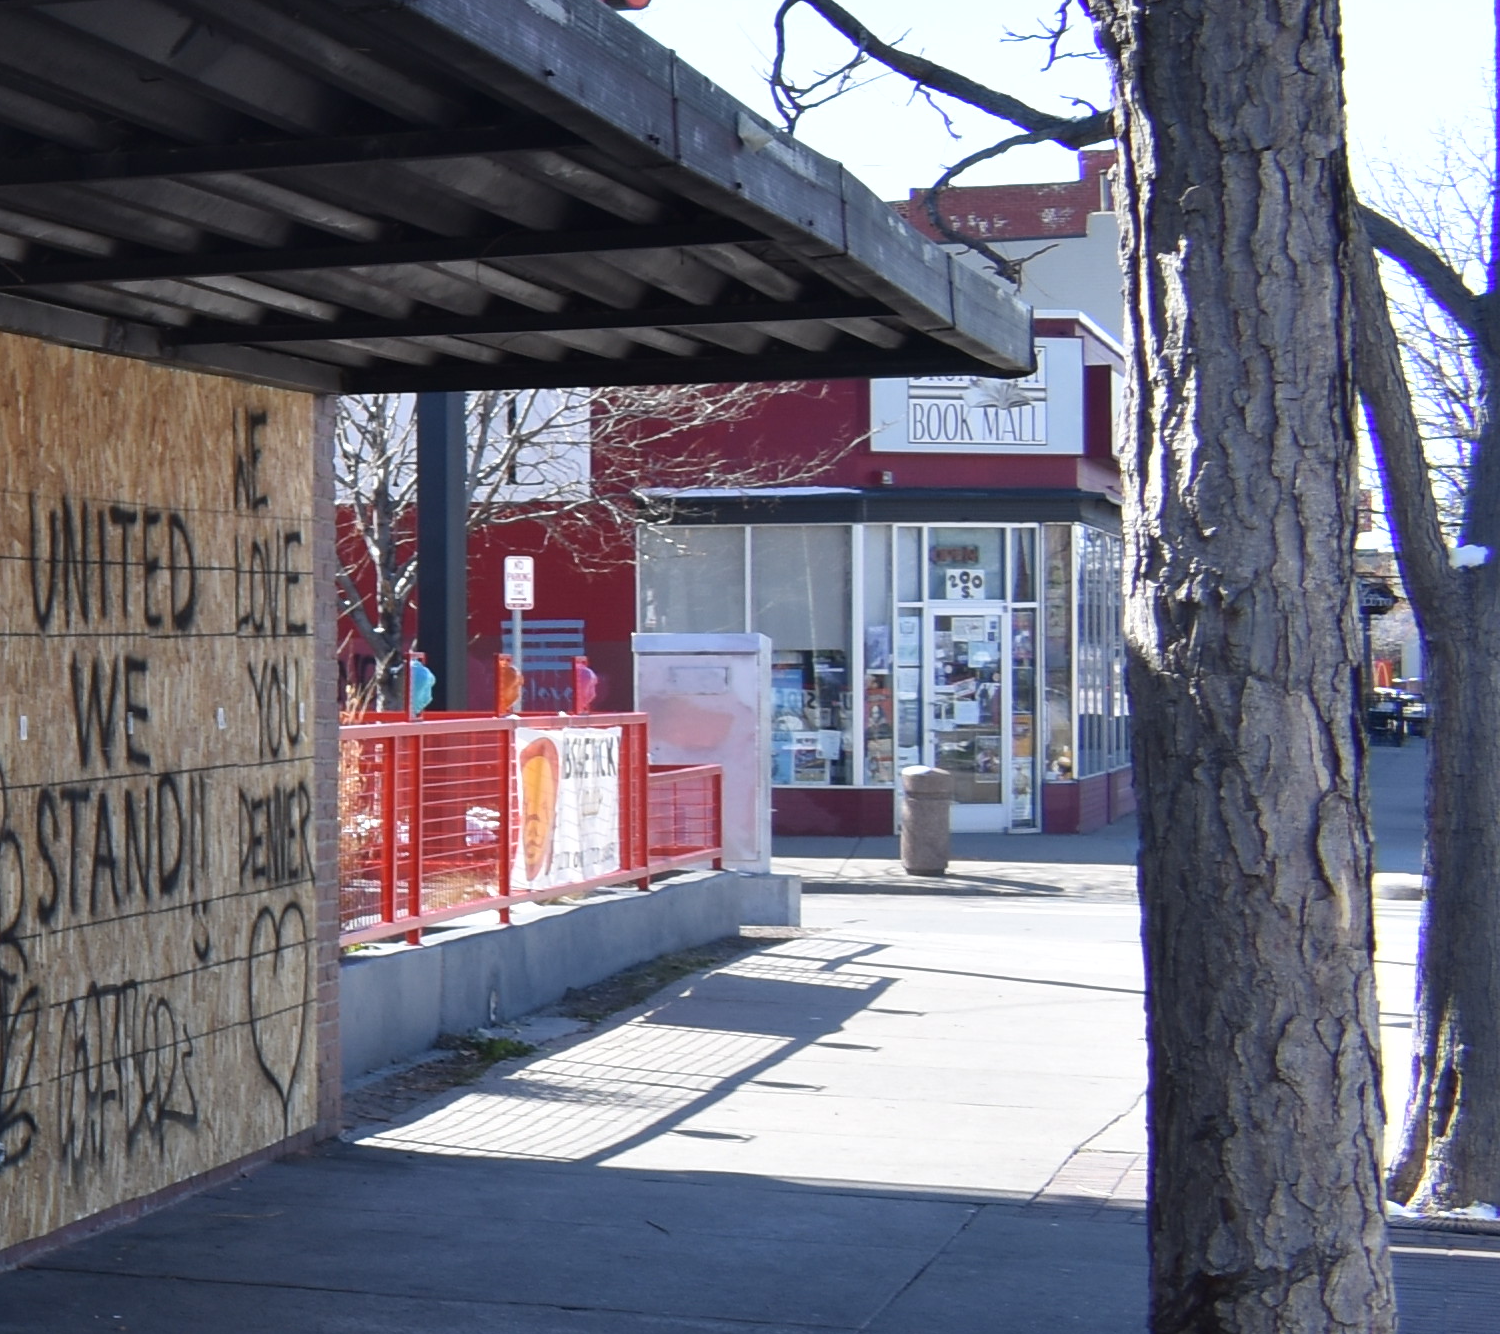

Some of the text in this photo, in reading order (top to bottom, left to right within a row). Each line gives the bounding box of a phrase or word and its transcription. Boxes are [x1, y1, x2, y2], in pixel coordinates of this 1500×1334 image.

[913, 403, 1043, 442] BOOK MALL
[29, 491, 199, 631] UNITED
[235, 527, 307, 635] LOVE
[948, 570, 983, 589] 200
[70, 650, 152, 770] WE
[248, 652, 299, 760] YOU
[238, 780, 316, 887] DENVER
